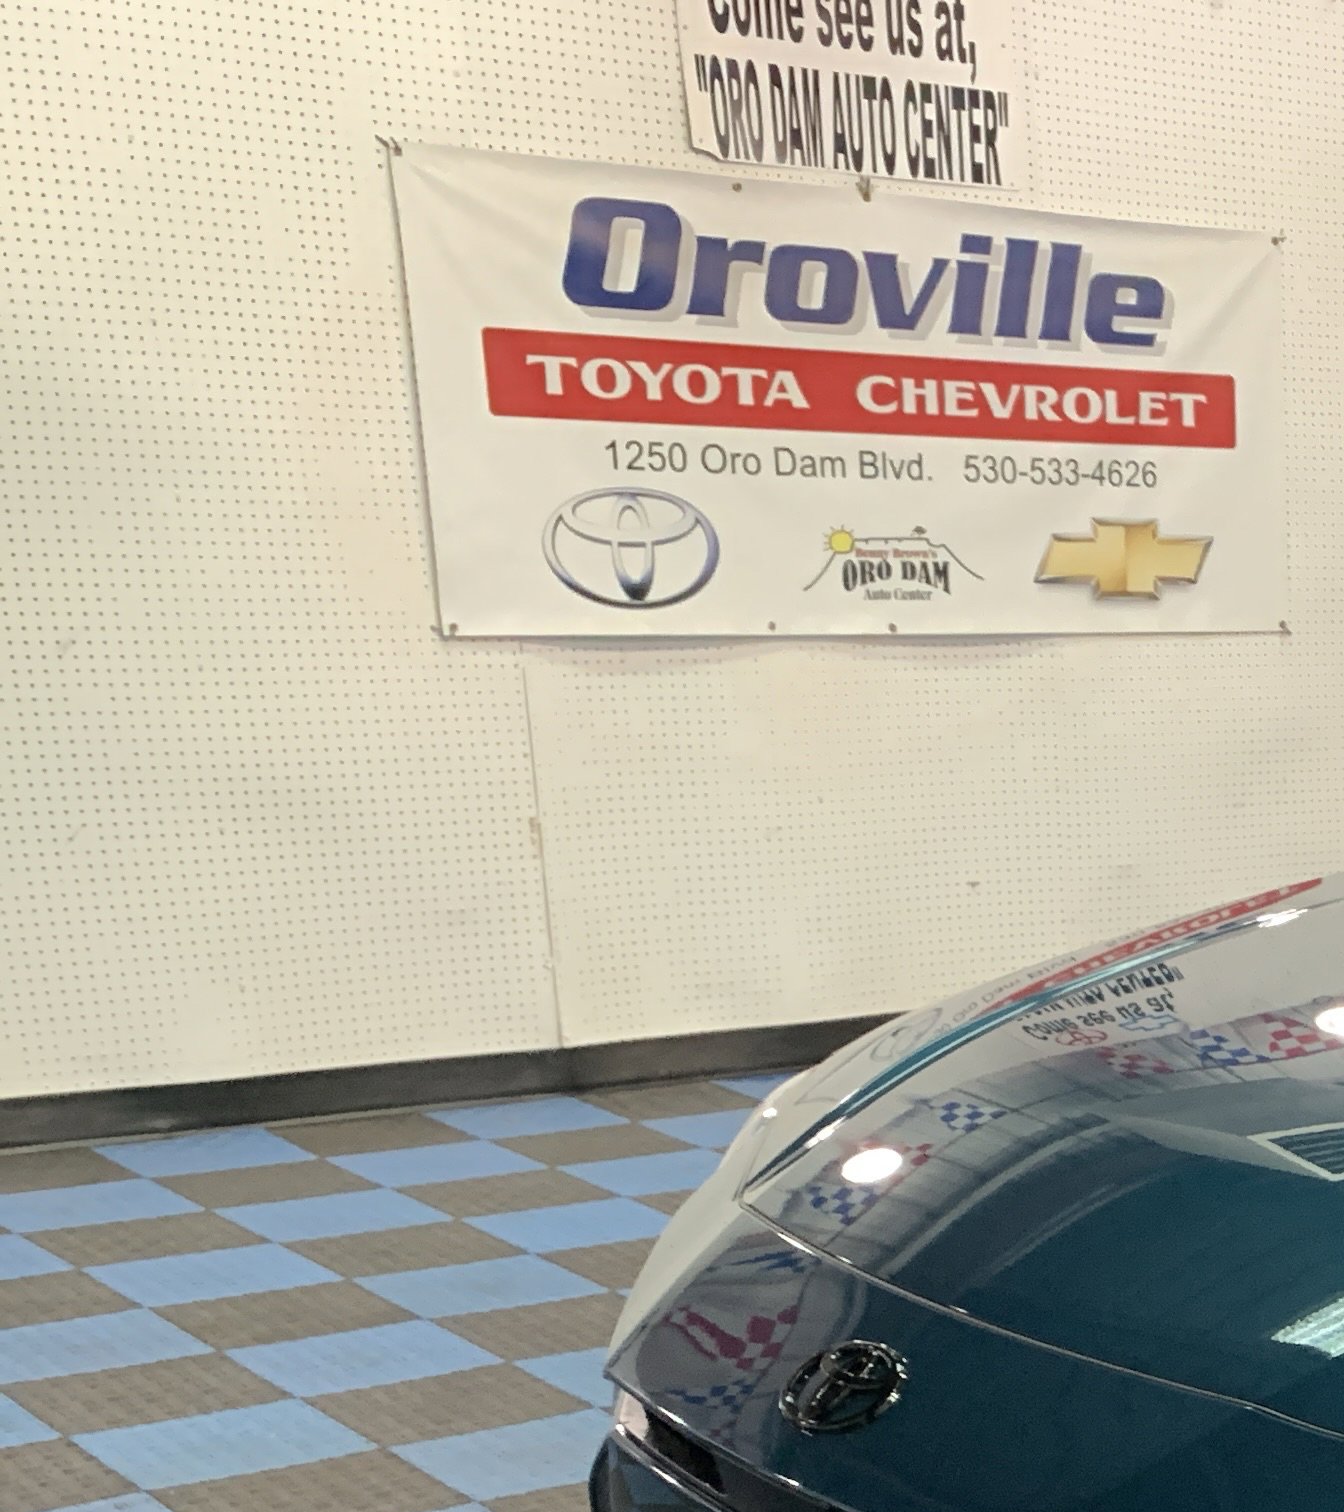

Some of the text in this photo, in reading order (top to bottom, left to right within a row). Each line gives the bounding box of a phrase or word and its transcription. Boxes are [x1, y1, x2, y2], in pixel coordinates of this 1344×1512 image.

[816, 0, 874, 52] see
[885, 0, 923, 59] us
[934, 0, 977, 85] at,
[768, 63, 826, 168] DAM
[832, 71, 897, 176] AUTO
[562, 196, 1168, 348] Oroville
[525, 353, 1208, 430] TOYOTA CHEVROLET
[604, 440, 1158, 489] 1250 Oro Dam Blvd. 530-533-4626
[842, 558, 952, 596] ORO DAM
[863, 588, 933, 601] Auto Center
